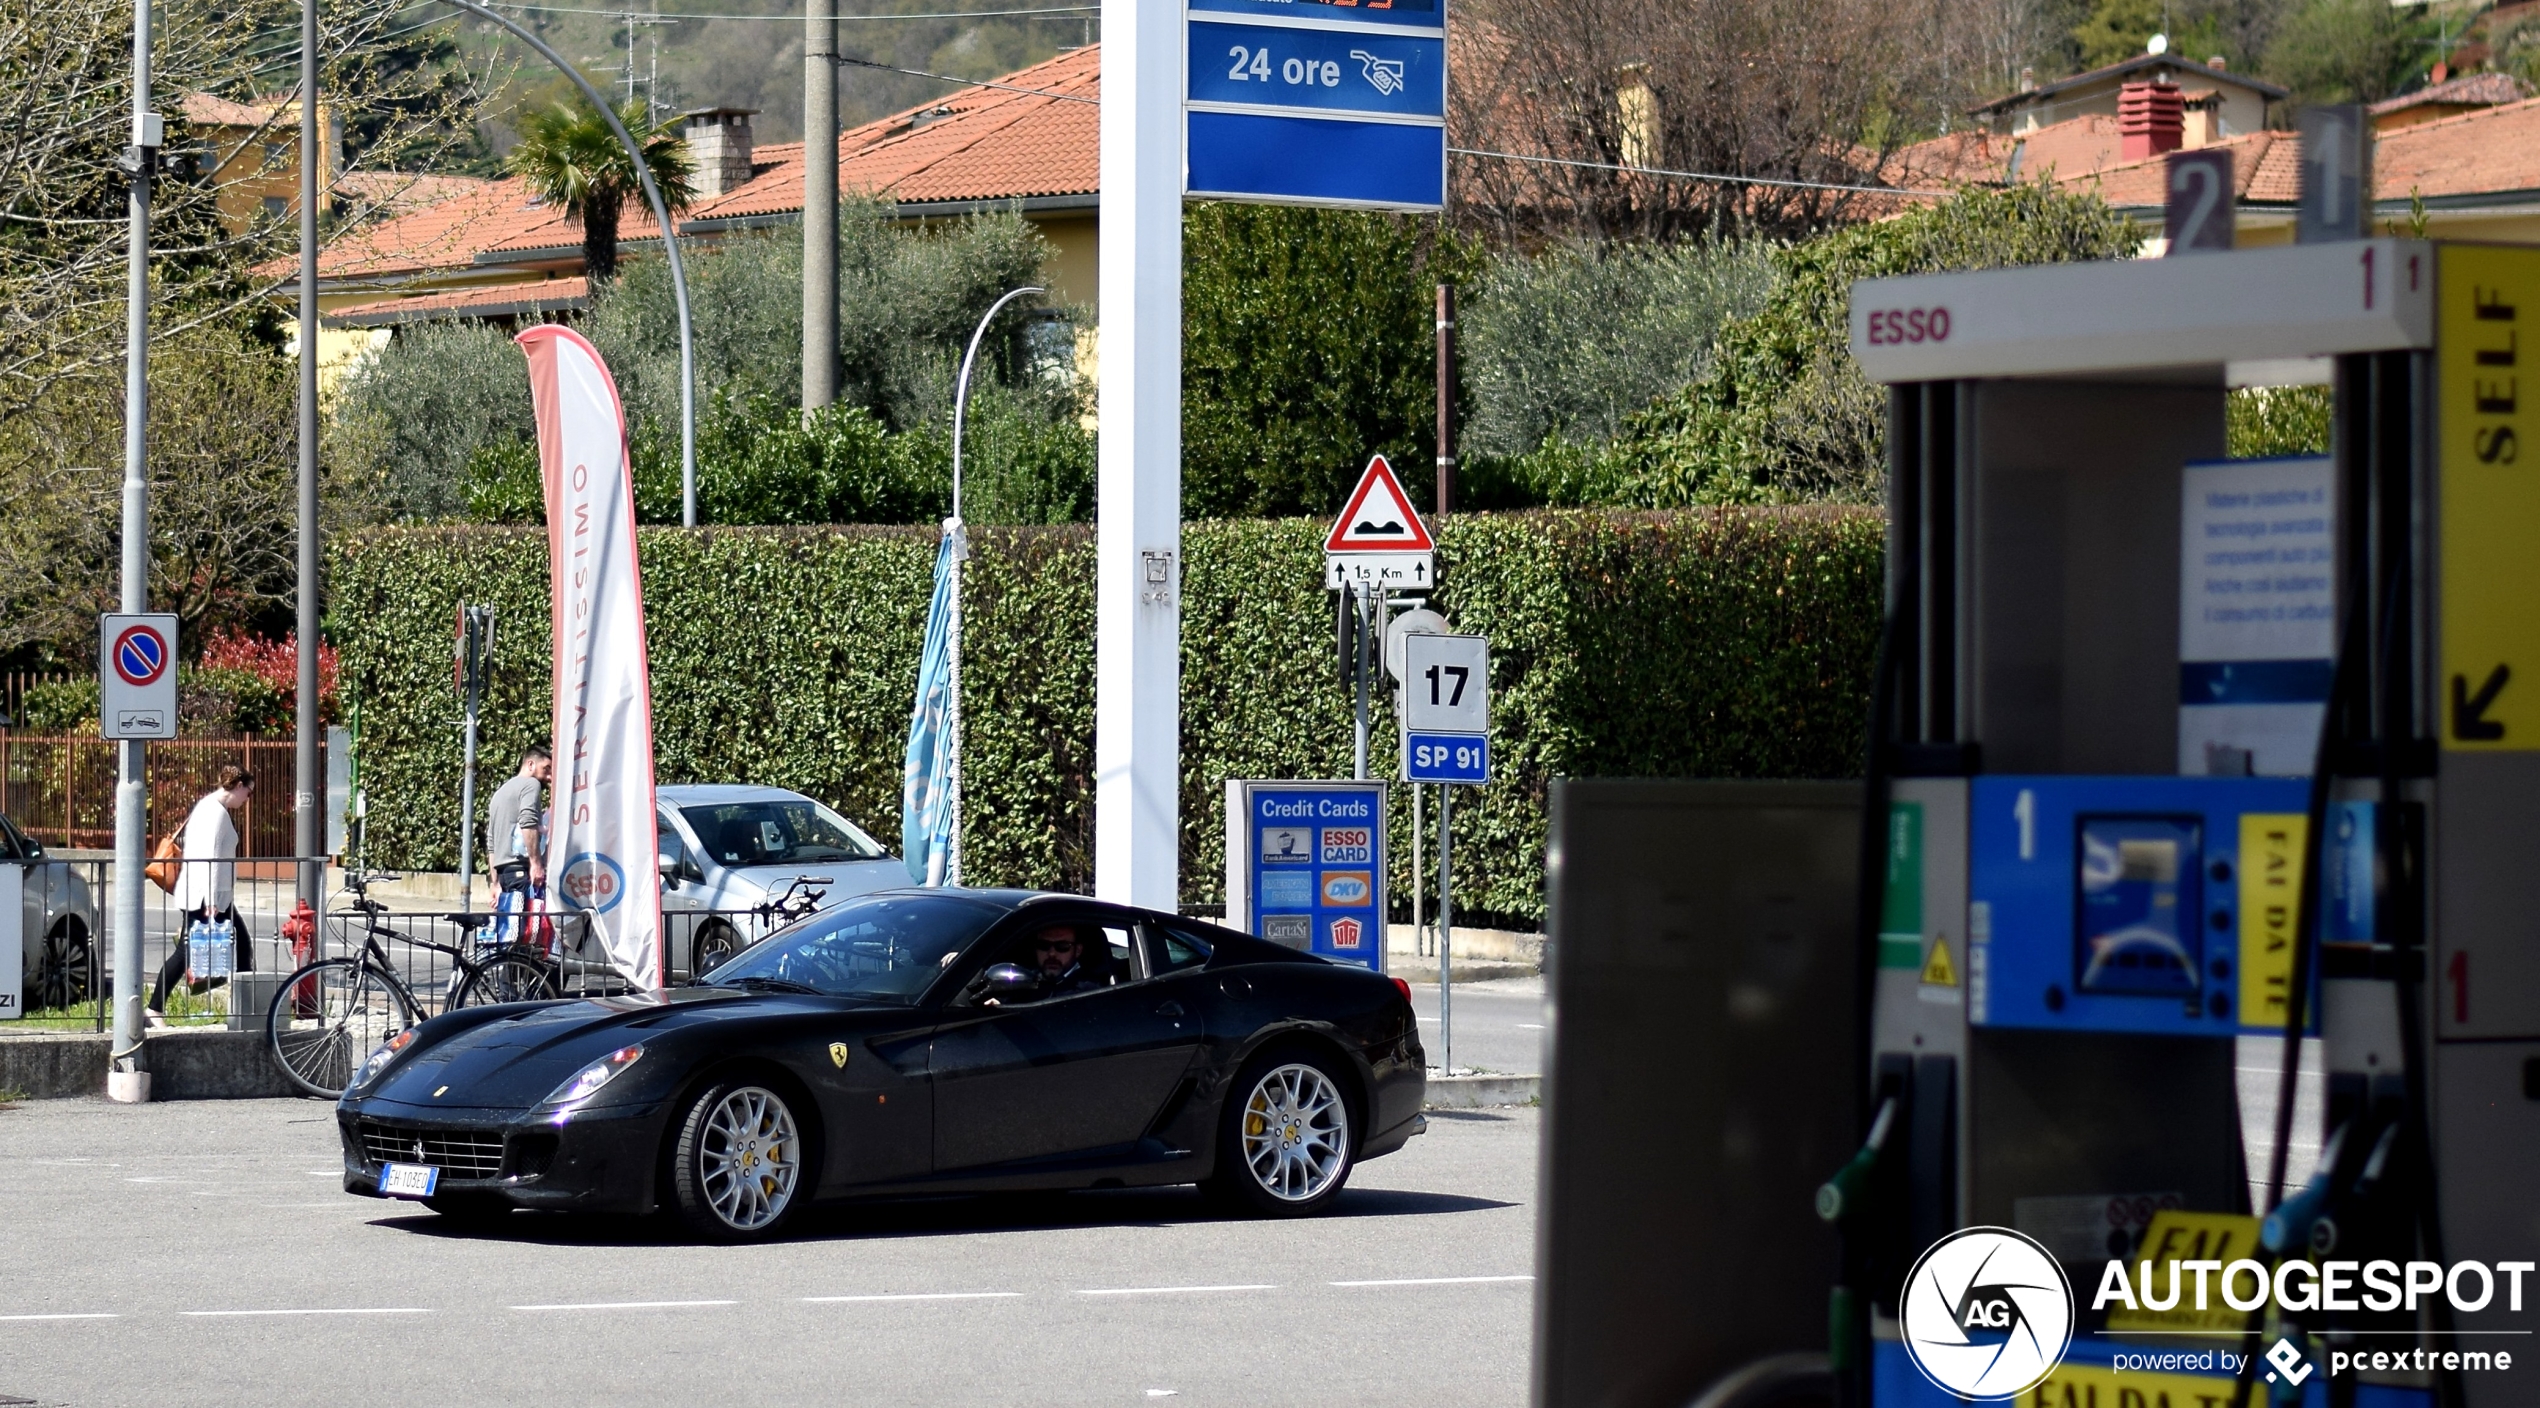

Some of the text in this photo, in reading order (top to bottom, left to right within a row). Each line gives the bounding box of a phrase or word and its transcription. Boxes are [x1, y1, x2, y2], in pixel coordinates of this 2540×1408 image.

[1228, 45, 1341, 87] 24 ore
[2170, 161, 2222, 254] 2
[2358, 245, 2376, 311] 1
[2406, 253, 2420, 293] 1
[1867, 306, 1952, 346] ESSO
[2473, 285, 2519, 465] SELF
[1354, 565, 1403, 580] 1,5 Km
[571, 462, 590, 828] SERVITISSIMO
[1425, 665, 1469, 707] 17
[1415, 745, 1481, 769] SP 91
[1262, 799, 1368, 817] Credit Cards
[2012, 789, 2036, 860] 1
[1323, 847, 1368, 862] CARD
[1324, 831, 1367, 846] ESSO
[2266, 830, 2287, 886] FAI
[1329, 882, 1364, 897] DKV
[1332, 918, 1361, 946] UTA
[2266, 906, 2287, 953] DA
[2447, 949, 2469, 1024] 1
